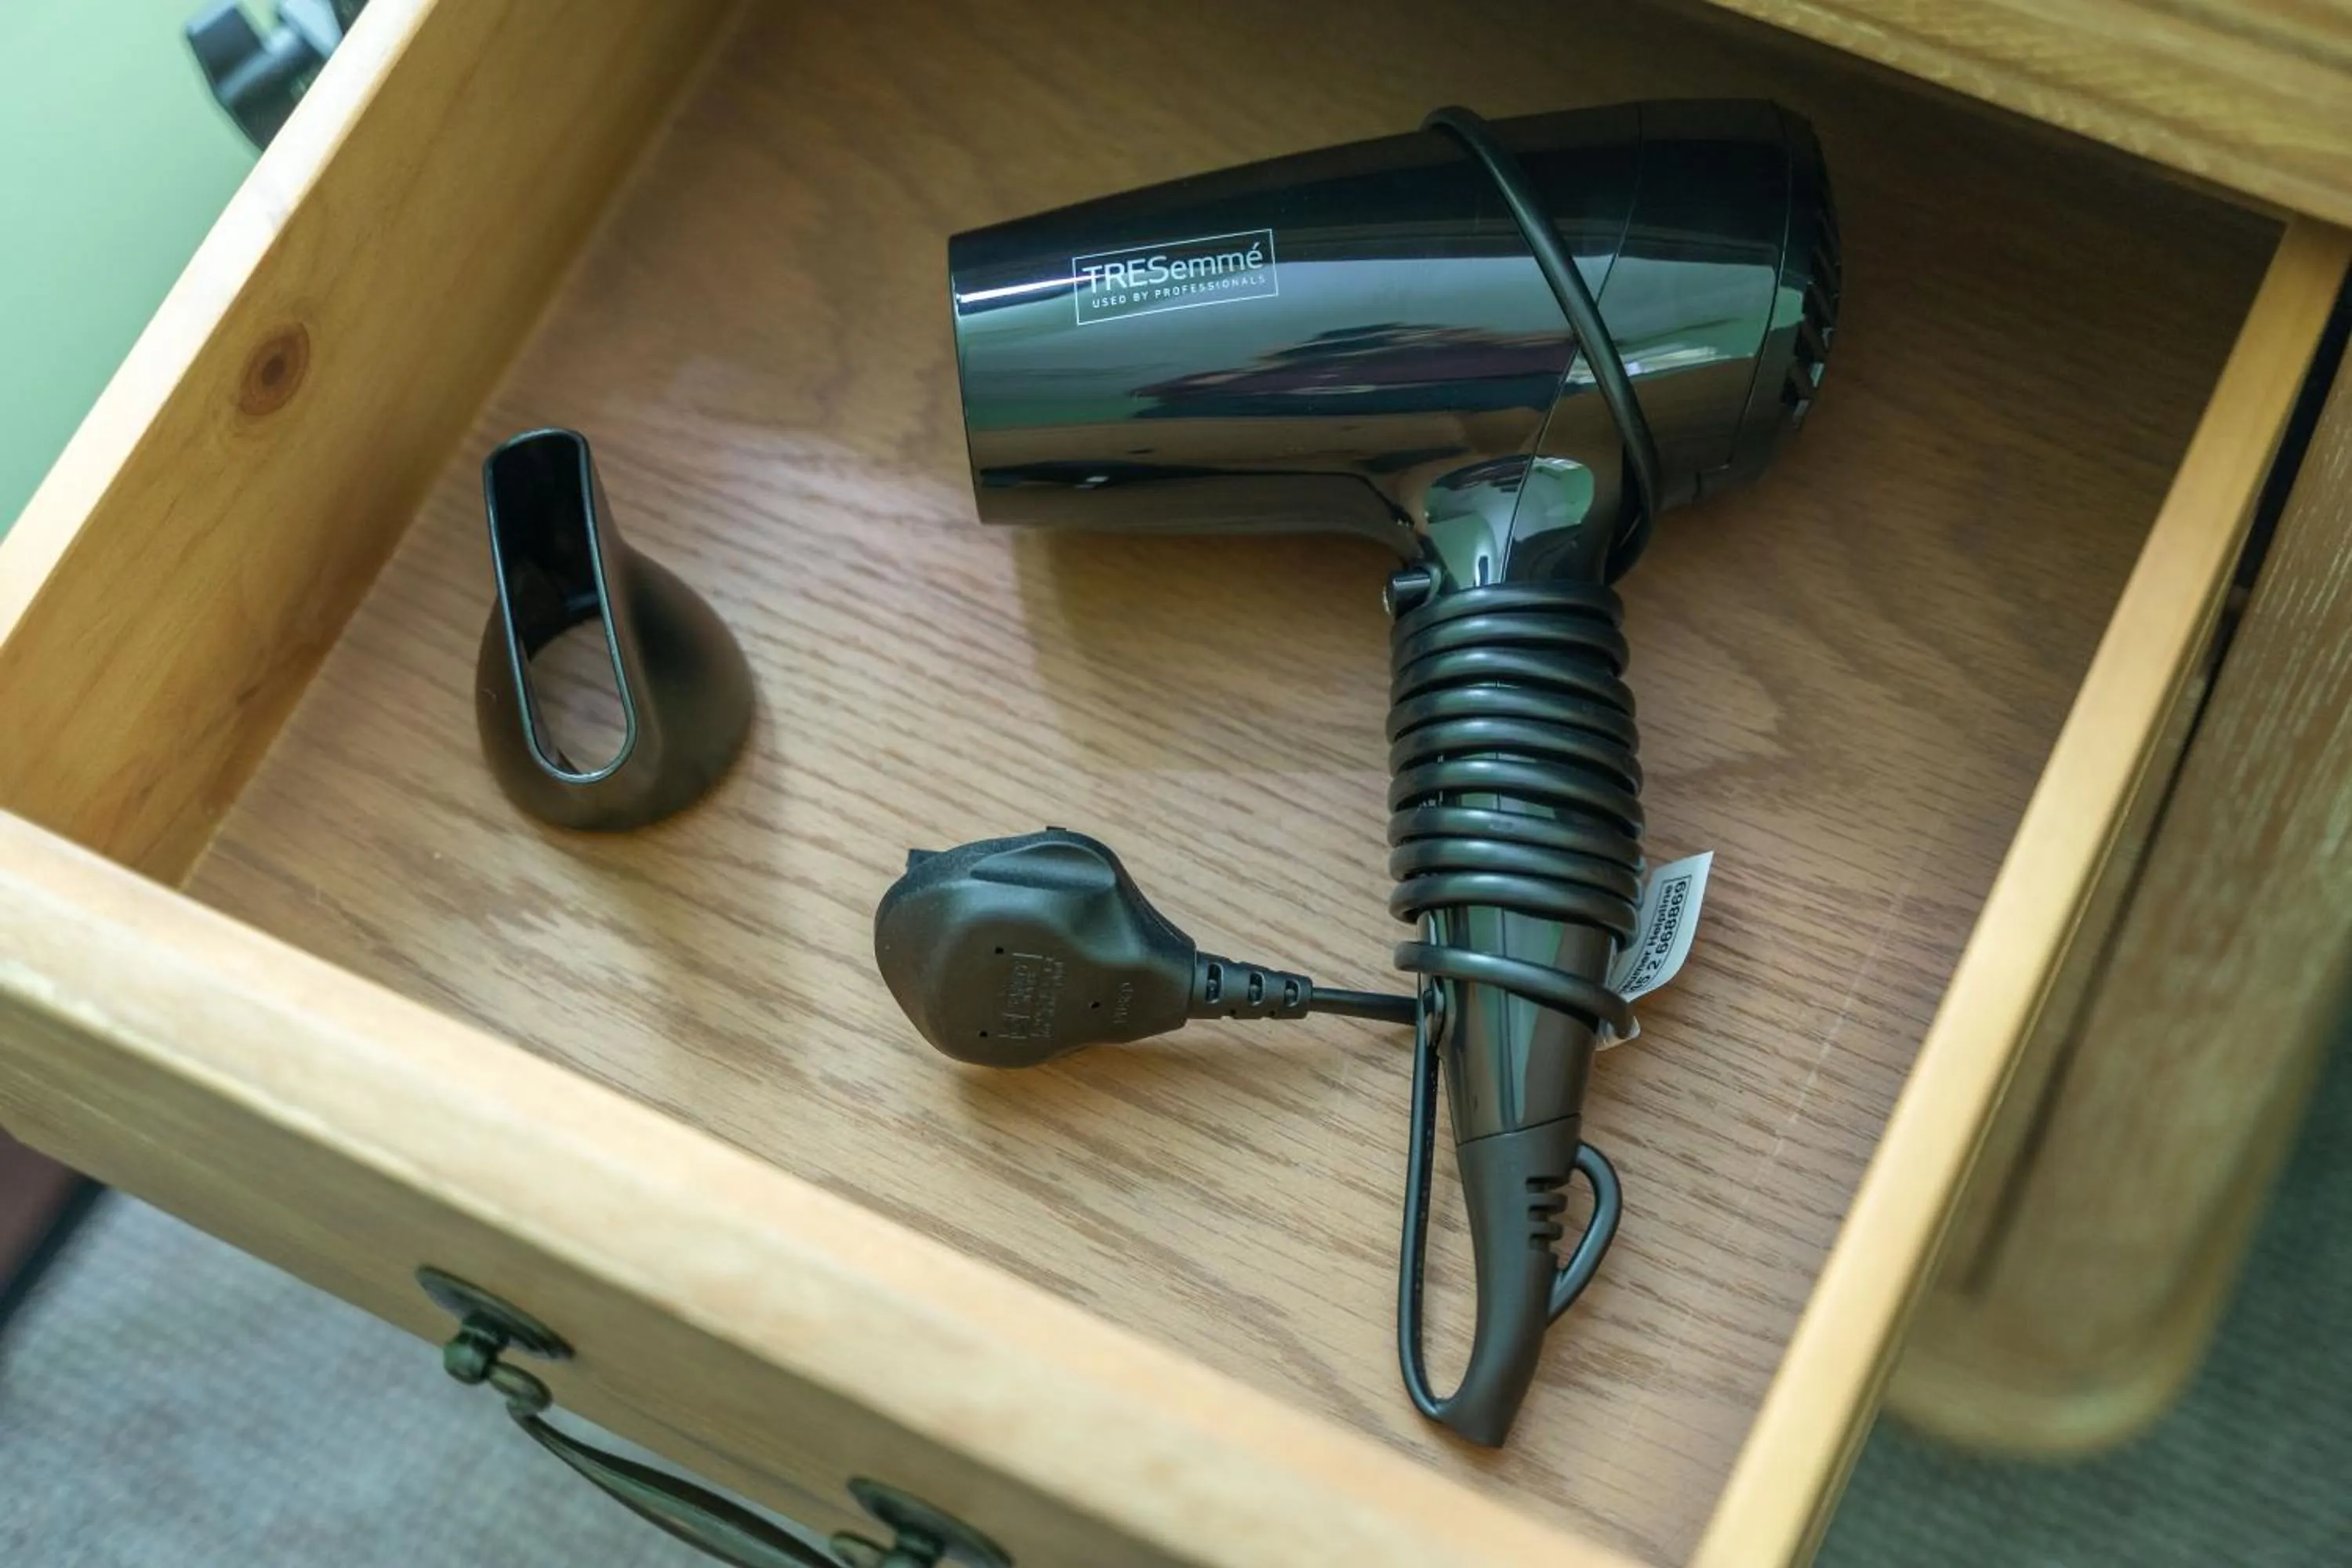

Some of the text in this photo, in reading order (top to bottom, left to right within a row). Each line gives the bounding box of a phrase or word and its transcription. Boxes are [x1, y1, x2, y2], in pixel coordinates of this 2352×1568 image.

[1082, 241, 1263, 293] TRESemmé
[1092, 274, 1266, 308] USED BY PROFESSIONALS
[1646, 959, 1661, 971] 2
[1655, 880, 1687, 955] 668869
[1647, 884, 1674, 947] Helpline
